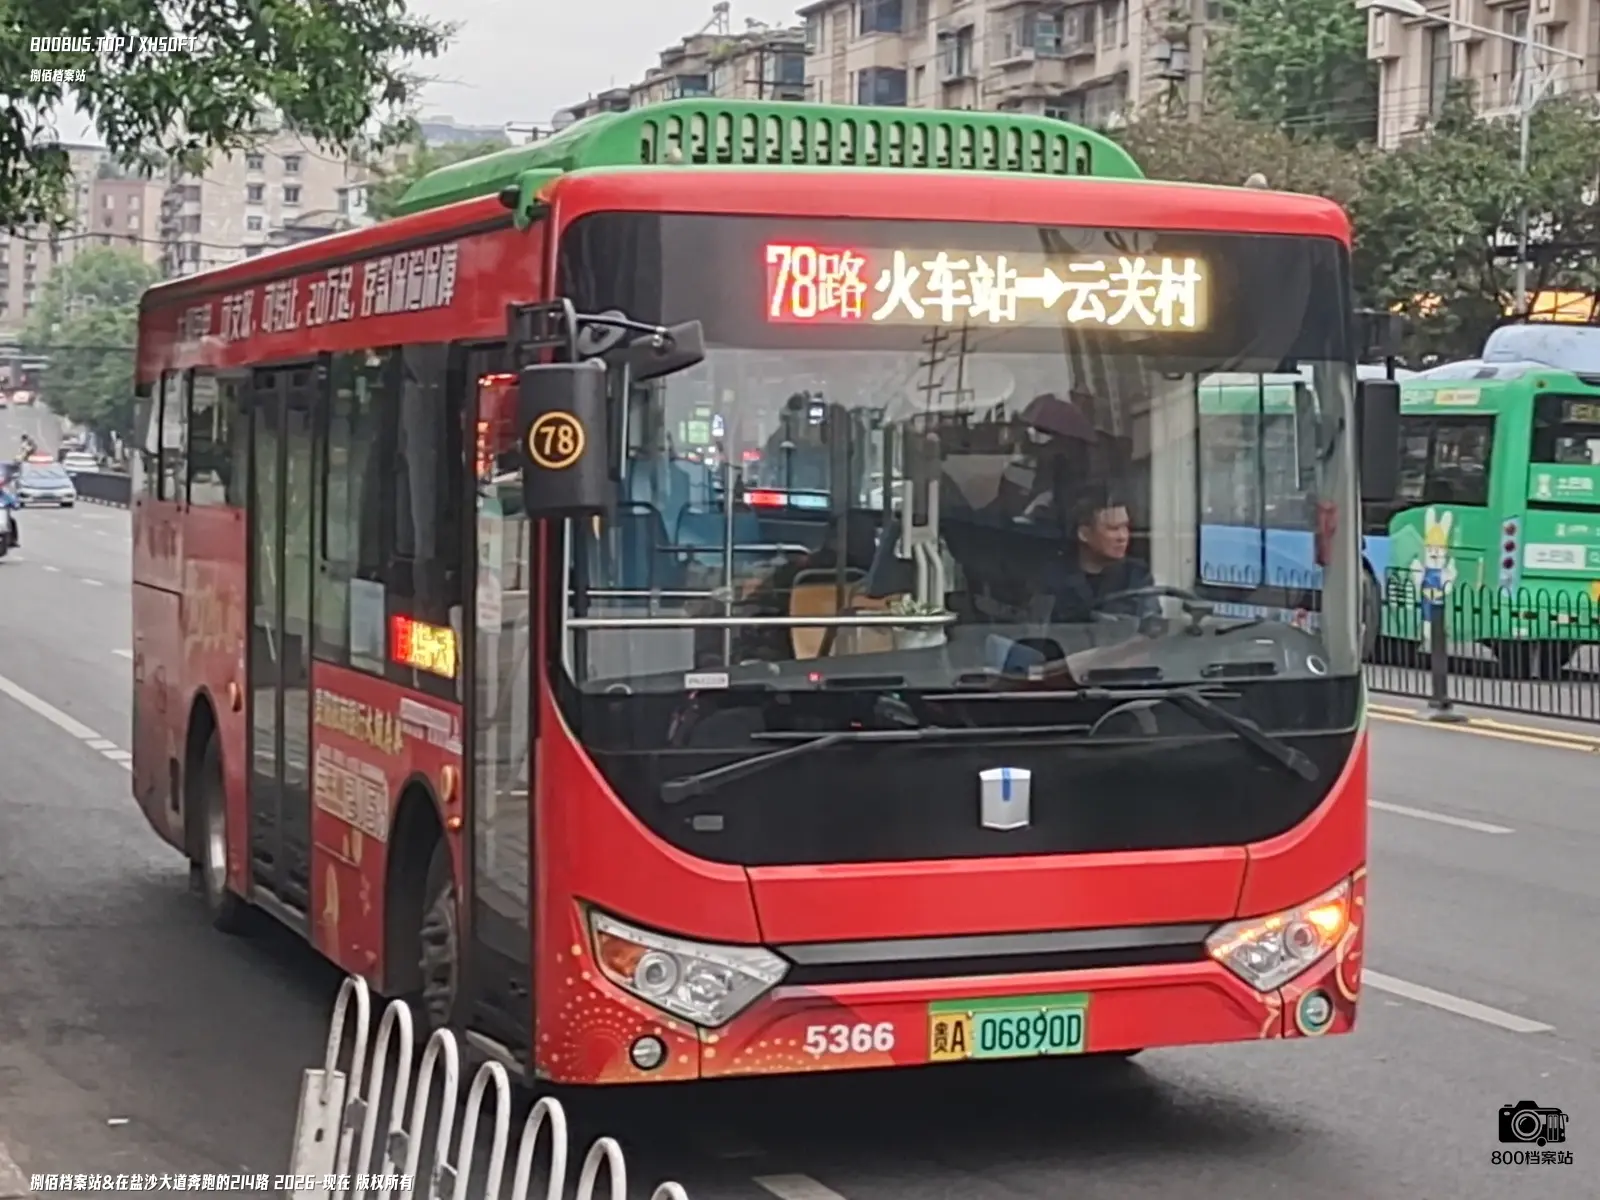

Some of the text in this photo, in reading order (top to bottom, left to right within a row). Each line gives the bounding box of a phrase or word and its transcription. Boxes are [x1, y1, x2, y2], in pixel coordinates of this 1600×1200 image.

[766, 243, 1202, 327] 78路 火车站 云关村
[539, 424, 575, 455] 78
[804, 1022, 895, 1054] 5366
